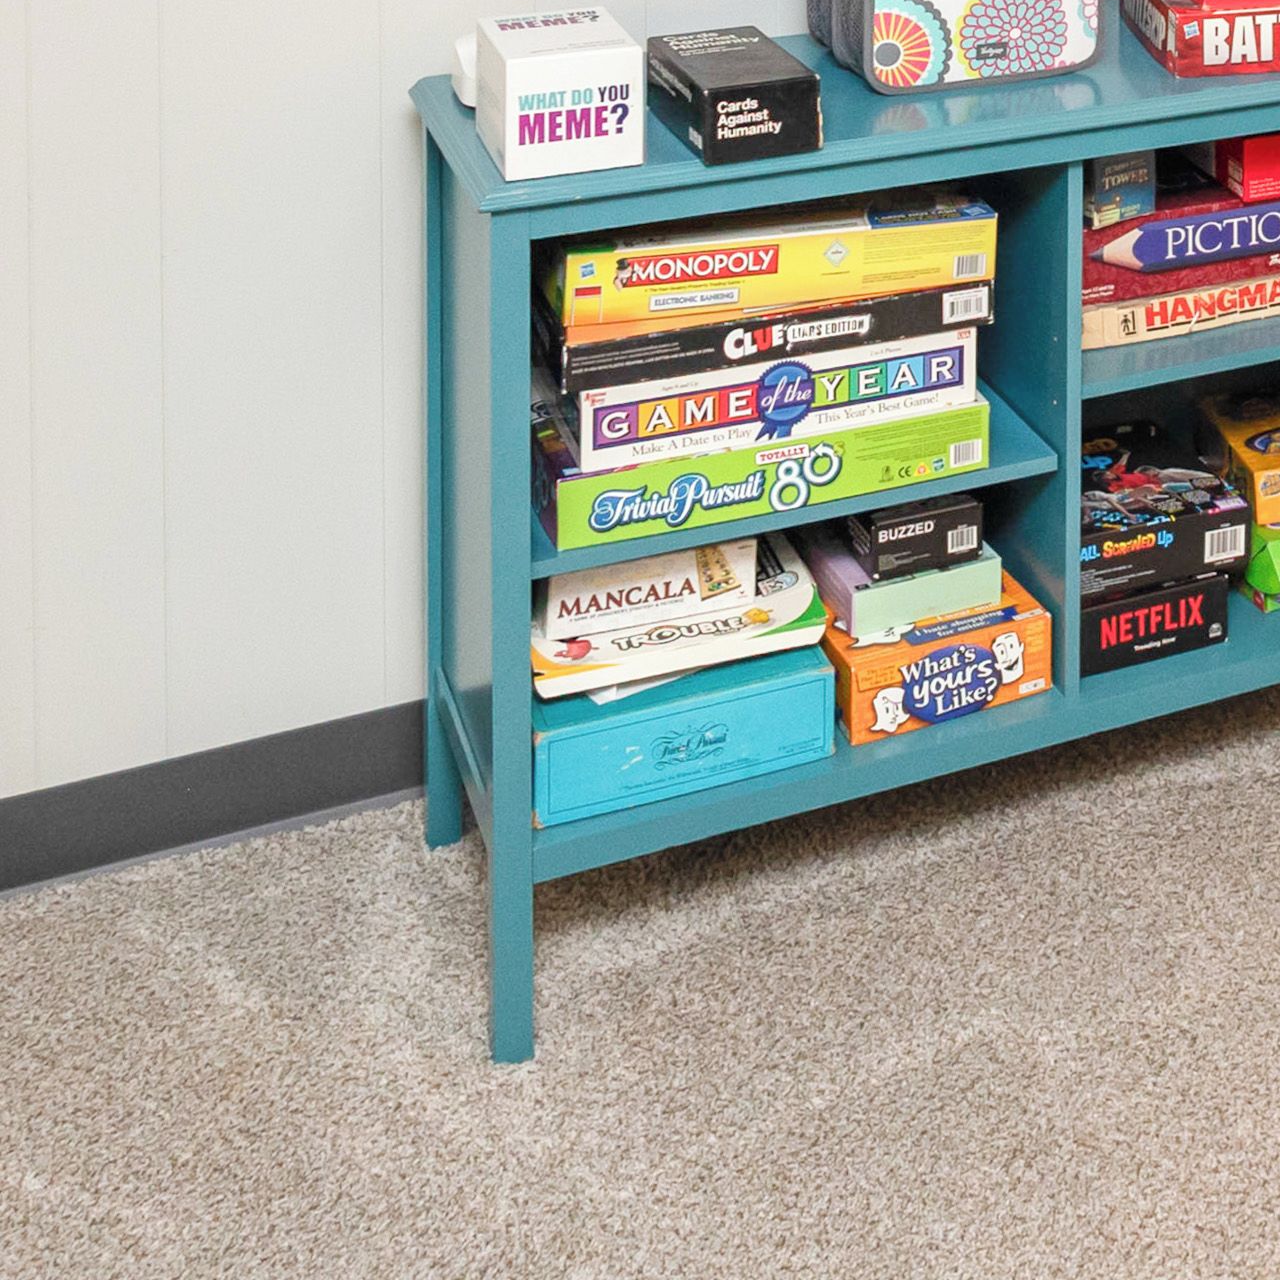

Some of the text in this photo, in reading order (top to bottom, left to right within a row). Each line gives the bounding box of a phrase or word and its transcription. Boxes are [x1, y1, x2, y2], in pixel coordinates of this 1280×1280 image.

[518, 83, 630, 112] WHAT DO YOU
[716, 98, 759, 114] Cards
[517, 103, 630, 146] MEME?
[716, 108, 770, 128] Against
[717, 120, 783, 141] Humanity
[631, 249, 775, 283] MONOPOLY
[723, 324, 784, 360] CLUE
[825, 319, 866, 334] EDITION
[601, 355, 955, 440] GAME of the YEAR
[815, 392, 940, 425] This Year's Best Game!
[632, 427, 754, 458] Make A Date to Play
[759, 447, 806, 462] TOTALLY
[589, 472, 767, 533] Trivial Pursuit
[878, 520, 935, 544] BUZZED
[557, 577, 697, 619] MANCALA
[611, 616, 745, 651] TROUBLE
[1100, 593, 1205, 651] NETFLIX
[900, 645, 977, 685] What's
[912, 659, 995, 709] yours
[934, 677, 999, 717] Like?
